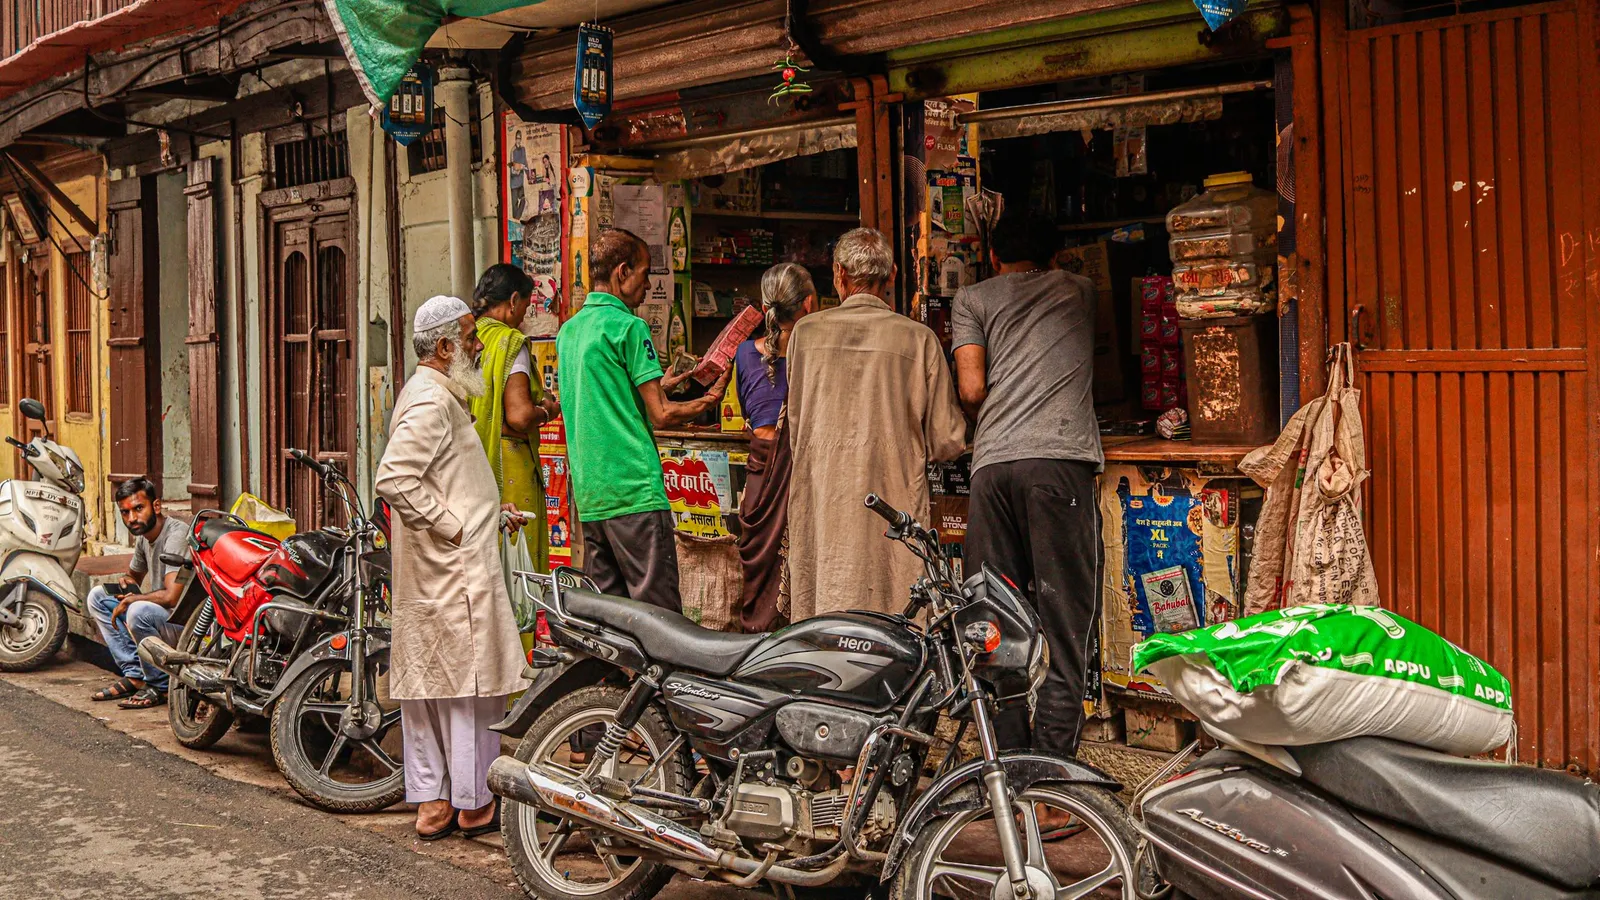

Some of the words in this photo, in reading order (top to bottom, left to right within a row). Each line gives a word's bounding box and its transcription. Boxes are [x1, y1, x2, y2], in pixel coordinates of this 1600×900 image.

[937, 143, 956, 151] FLASH
[691, 513, 716, 526] मसाला
[1150, 529, 1169, 541] XL
[838, 636, 872, 652] Hero
[1384, 658, 1431, 680] APPU
[1474, 683, 1512, 709] APPU
[1176, 808, 1271, 855] Activa
